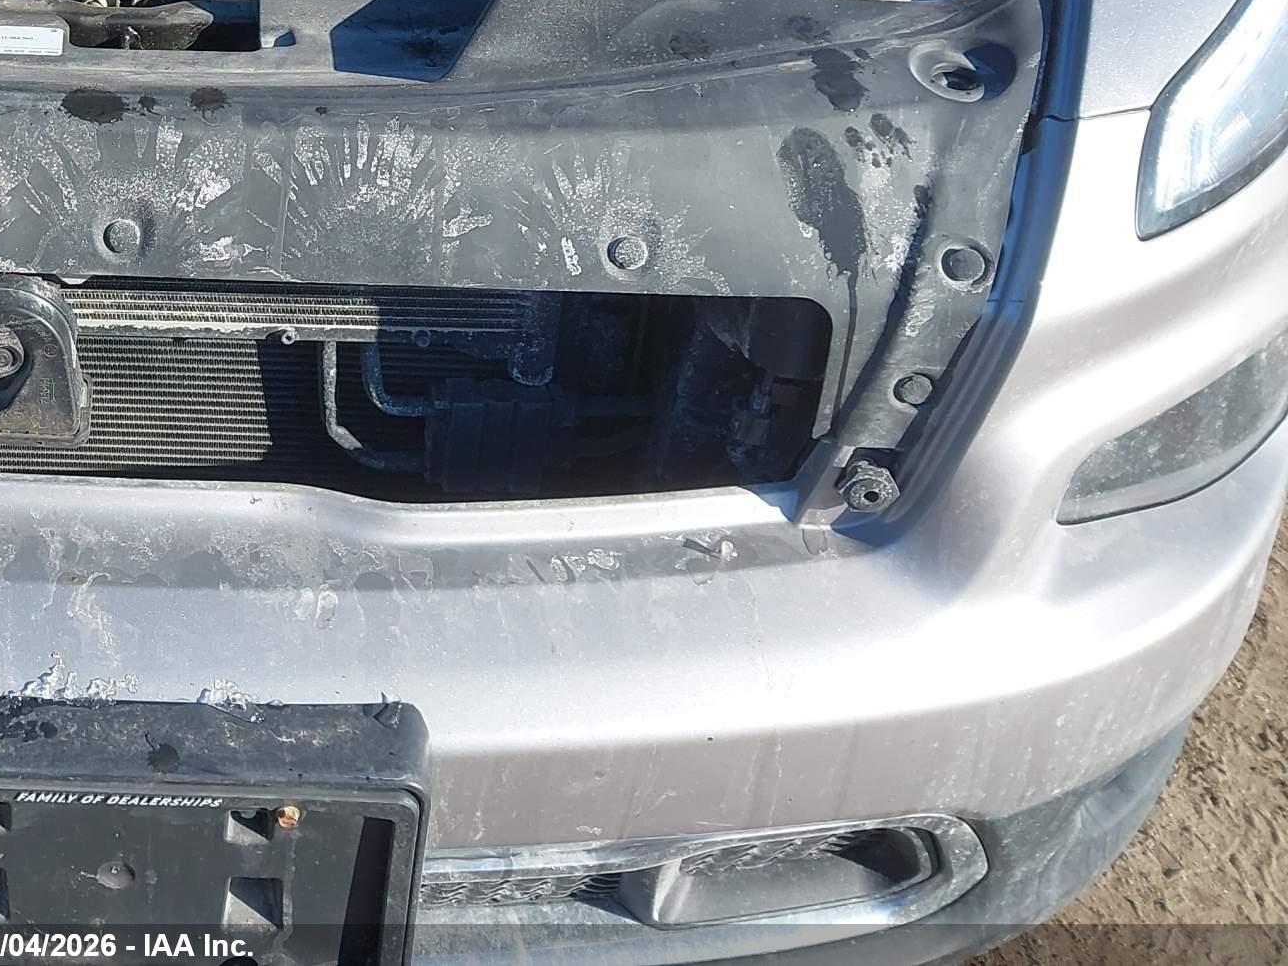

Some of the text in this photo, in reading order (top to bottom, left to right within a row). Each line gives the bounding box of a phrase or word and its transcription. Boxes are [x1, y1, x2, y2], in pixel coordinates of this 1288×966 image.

[16, 791, 79, 804] FAMILY
[81, 794, 105, 805] OF
[107, 795, 223, 808] DEALERSHIPS
